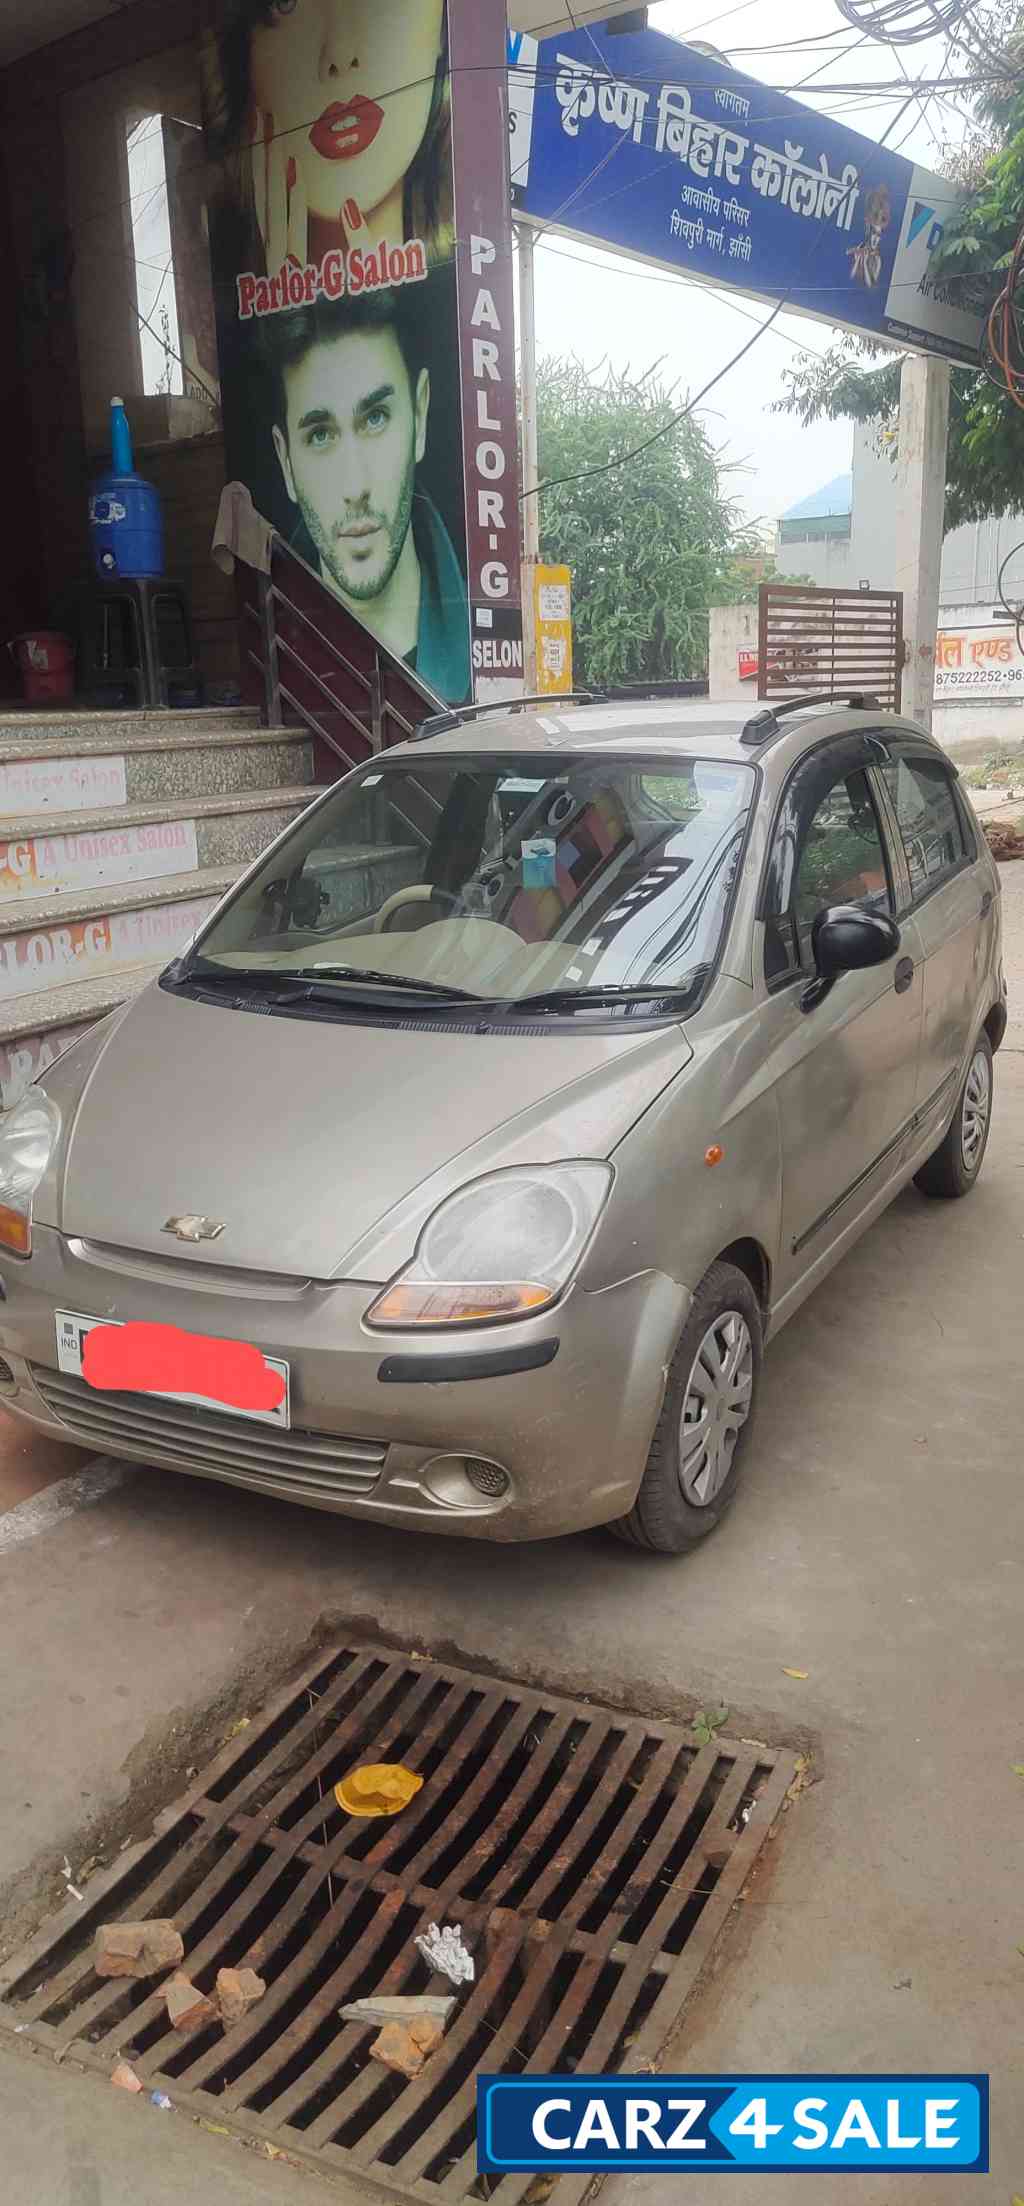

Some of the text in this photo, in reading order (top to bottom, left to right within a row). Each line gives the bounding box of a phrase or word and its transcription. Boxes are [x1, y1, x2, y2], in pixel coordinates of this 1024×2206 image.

[555, 53, 860, 231] कृष्ण बिहार कॉलोनी
[680, 184, 751, 228] आवासीय परिसर
[670, 209, 704, 249] शिवपुरी
[348, 239, 426, 293] Salon
[472, 639, 523, 669] SELON
